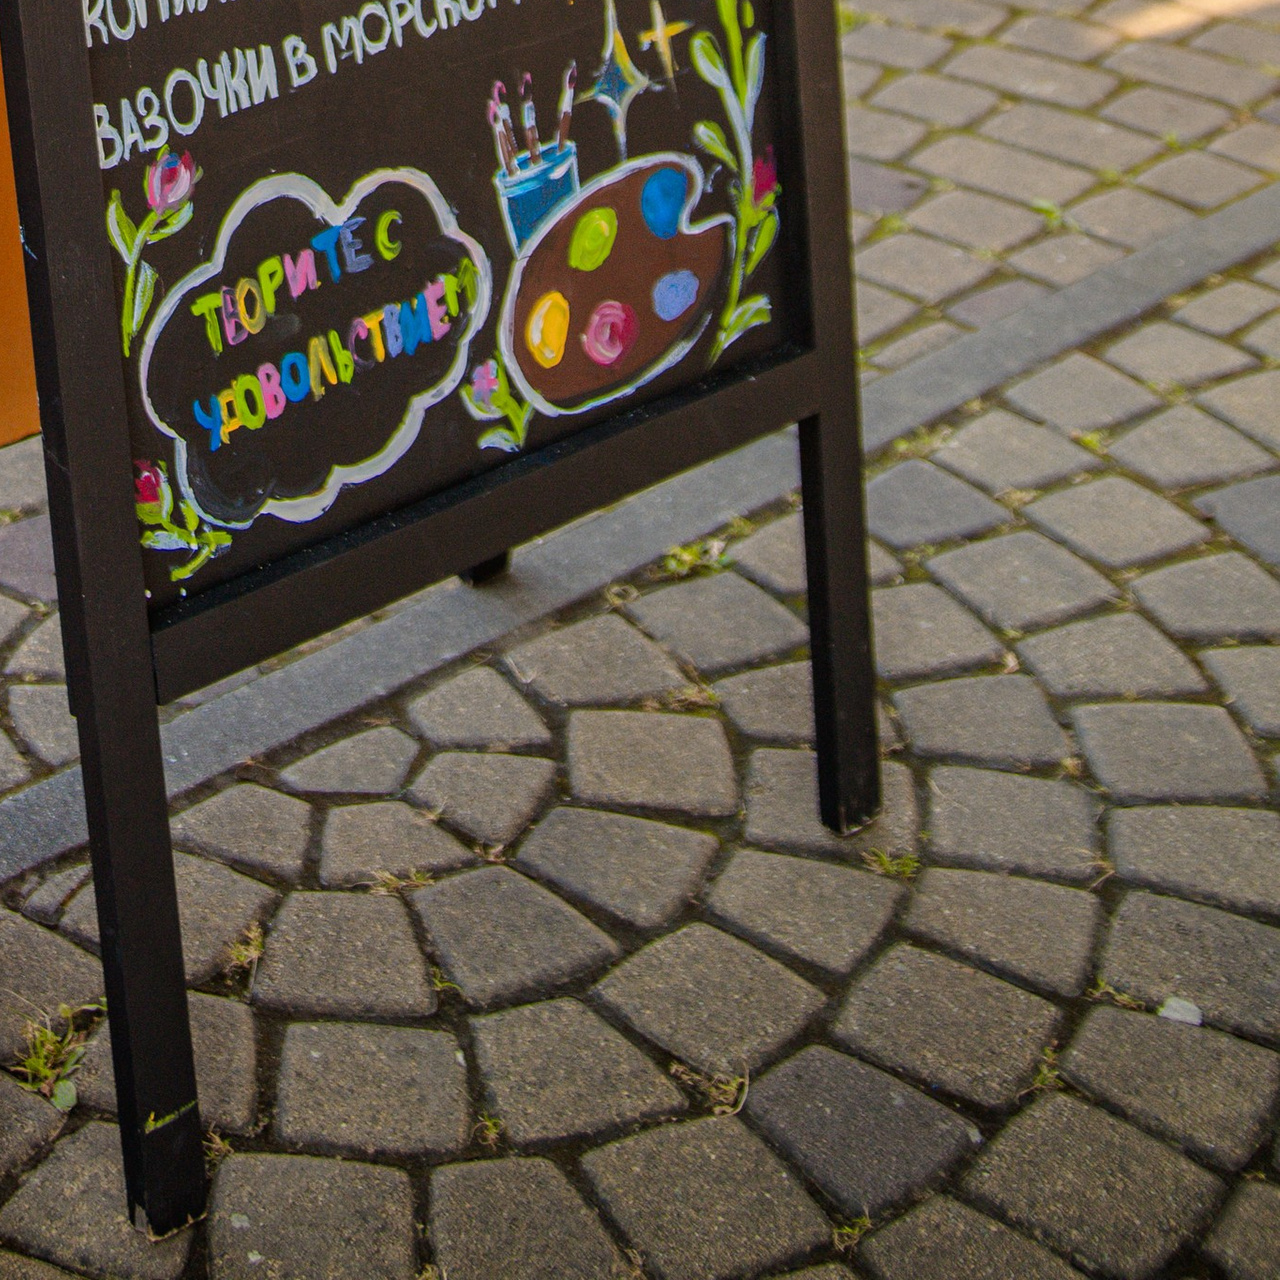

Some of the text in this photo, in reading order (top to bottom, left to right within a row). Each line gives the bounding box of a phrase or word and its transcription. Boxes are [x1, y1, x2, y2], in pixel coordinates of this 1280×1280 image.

[92, 43, 280, 169] ВАЗОЧКИ
[190, 216, 374, 356] ТВОРИТЕ
[192, 257, 480, 452] УДОВОЛЬСТВИЕМ
